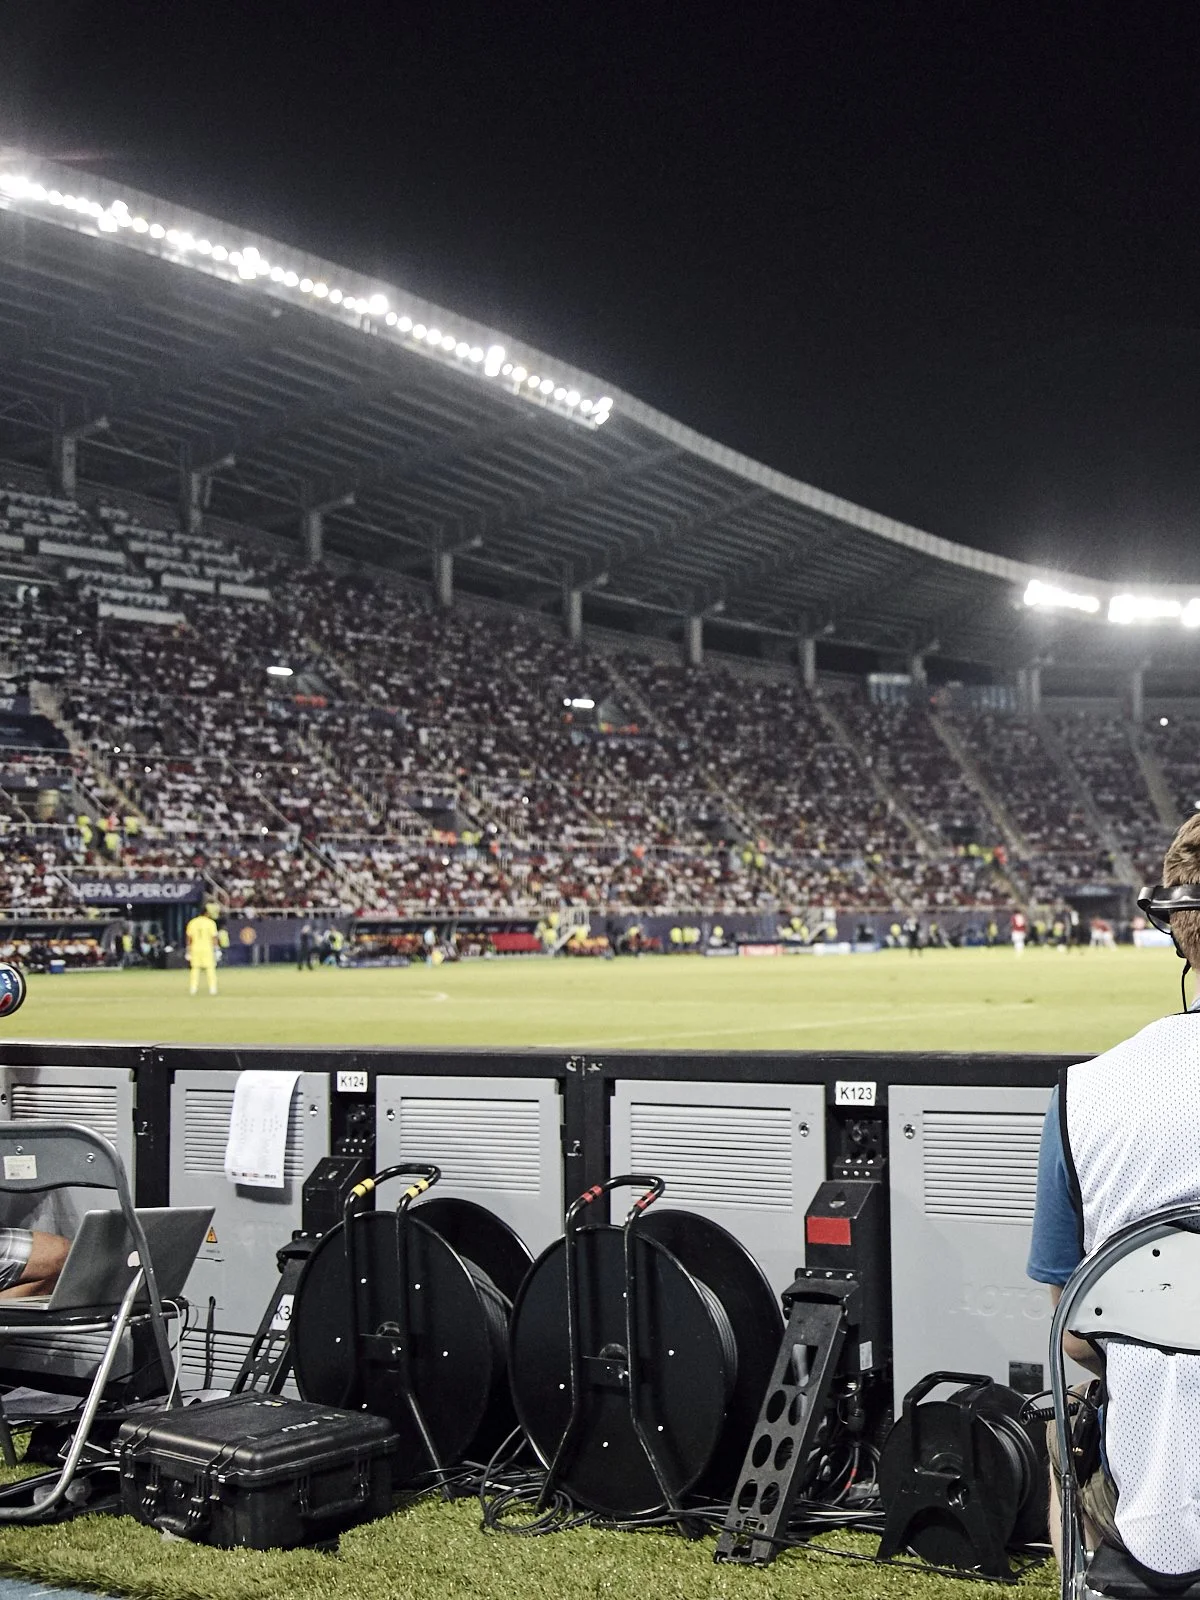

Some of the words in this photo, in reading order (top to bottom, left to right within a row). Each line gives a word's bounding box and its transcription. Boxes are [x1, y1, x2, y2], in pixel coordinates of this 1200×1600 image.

[82, 882, 113, 898] UEFA
[161, 883, 193, 898] CUP
[340, 1076, 365, 1088] K124
[840, 1087, 873, 1100] K123
